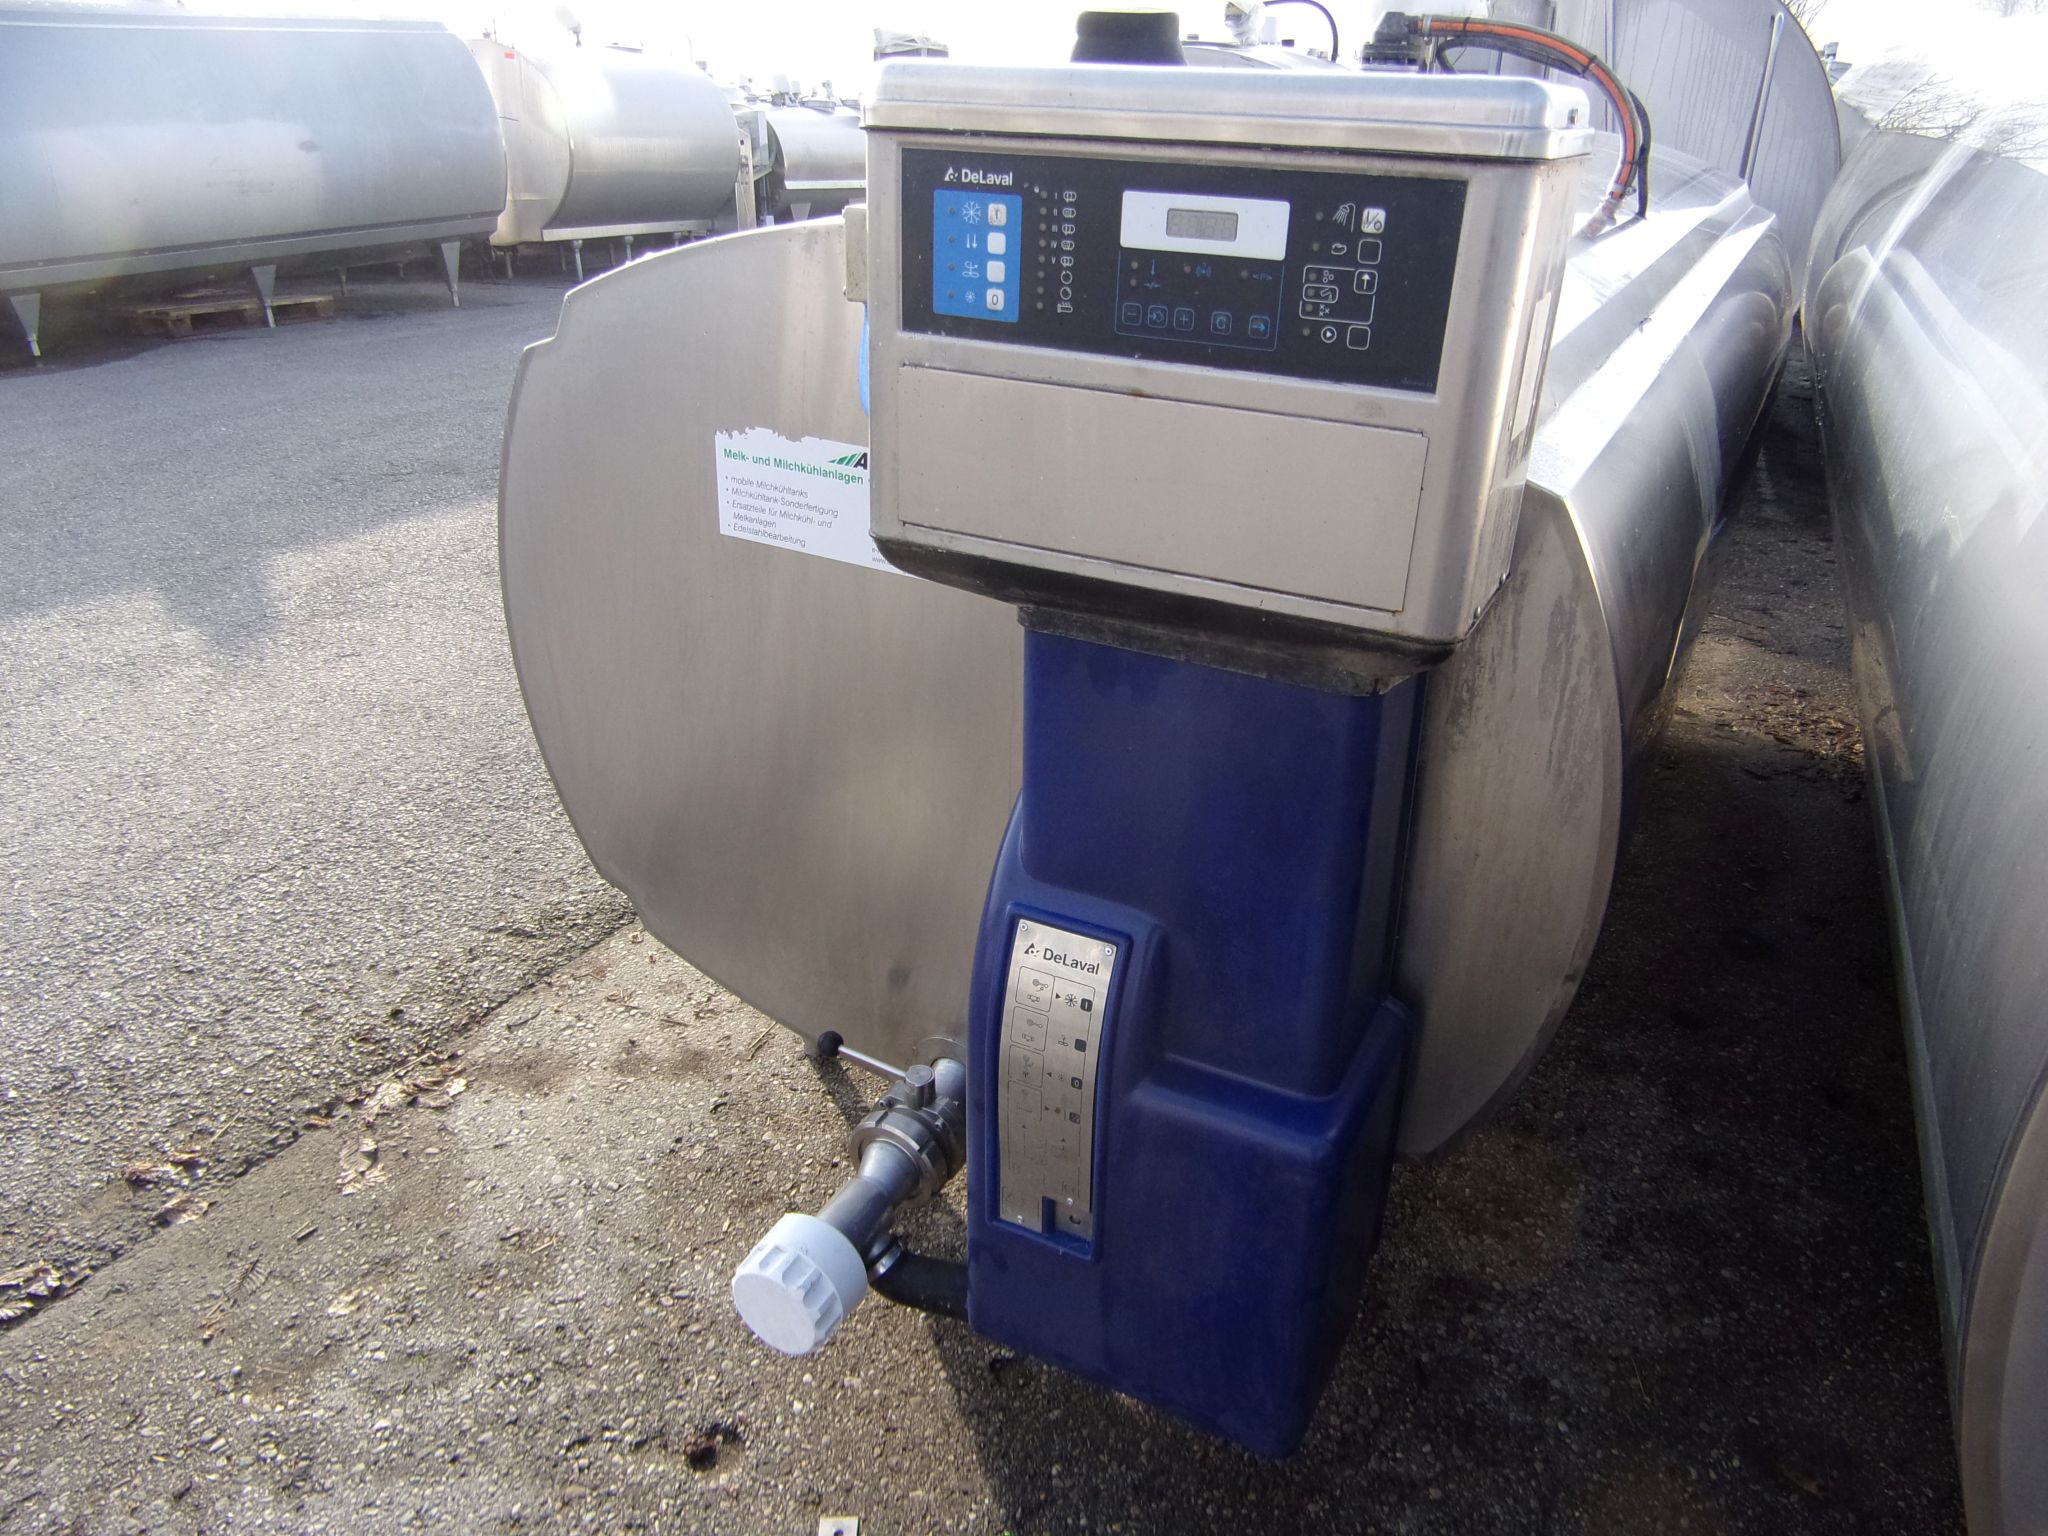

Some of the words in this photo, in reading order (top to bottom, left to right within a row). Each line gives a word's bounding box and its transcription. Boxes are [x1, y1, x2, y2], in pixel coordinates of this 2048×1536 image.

[961, 168, 1013, 186] DeLaval
[723, 448, 749, 462] Melk-
[752, 455, 770, 467] und
[773, 458, 864, 485] Milchkühlanlagen
[731, 476, 754, 488] mobile
[756, 480, 808, 499] Milchkühltanks
[731, 488, 839, 519] Milchkühltank-Sonderfertigung
[732, 500, 767, 515] Ersatzteile
[768, 507, 777, 517] für
[779, 510, 816, 526] Milchkühl-
[817, 518, 833, 529] und
[733, 512, 777, 529] Melkanlagen
[733, 524, 806, 548] Edelstahlbearbeitung
[1043, 947, 1101, 976] DeLaval
